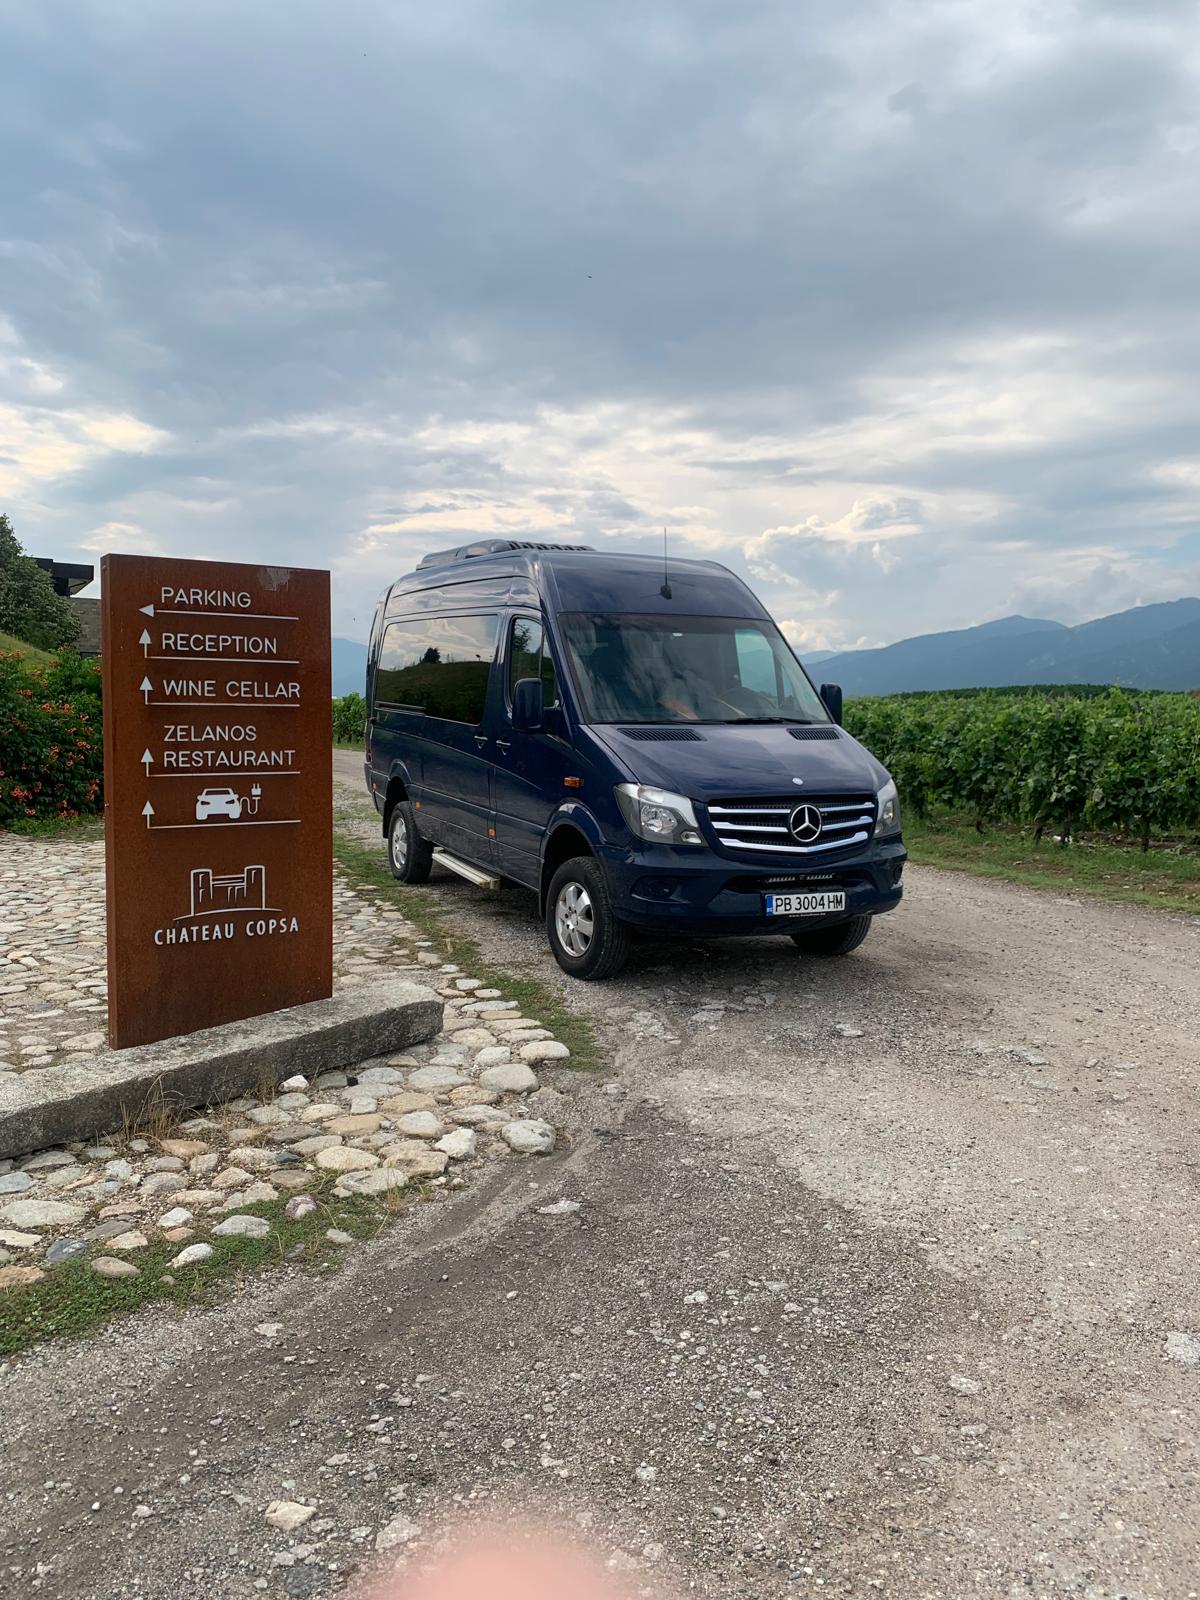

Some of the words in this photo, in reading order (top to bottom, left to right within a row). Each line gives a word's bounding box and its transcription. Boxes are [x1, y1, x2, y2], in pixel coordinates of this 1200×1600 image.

[161, 586, 252, 608] PARKING
[162, 632, 277, 654] RECEPTION
[163, 679, 217, 697] WINE
[226, 681, 300, 698] CELLAR
[163, 725, 257, 742] ZELANOS
[164, 750, 296, 768] RESTAURANT
[154, 923, 235, 945] CHATEAU
[245, 917, 299, 936] COPSA
